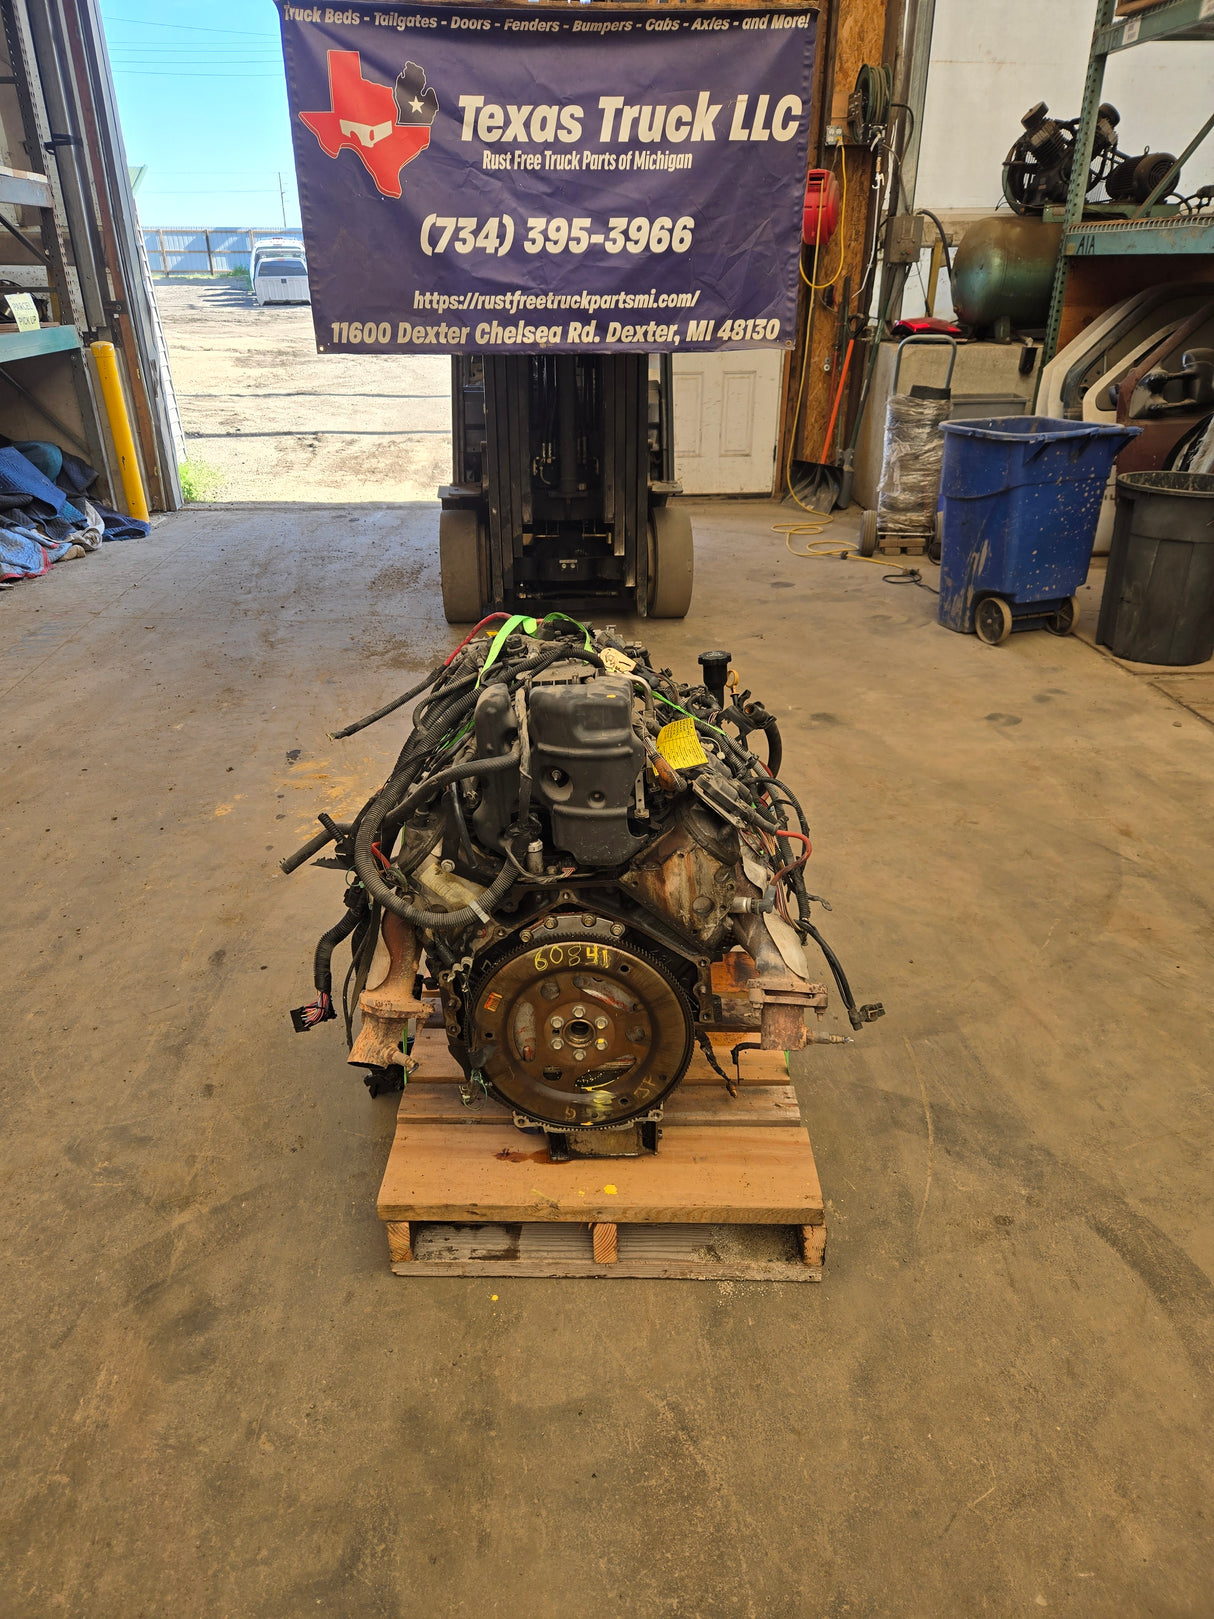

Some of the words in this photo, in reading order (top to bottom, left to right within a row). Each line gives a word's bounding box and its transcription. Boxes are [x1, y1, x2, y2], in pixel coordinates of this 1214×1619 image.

[284, 5, 321, 22] Truck
[324, 9, 360, 24] Beds
[375, 13, 437, 30] Tailgates
[451, 16, 491, 29] Doors
[504, 19, 560, 32] Fenders
[573, 20, 632, 34] Bumpers
[646, 18, 680, 30] Cabs
[691, 17, 730, 30] Axles
[742, 15, 768, 29] and
[771, 13, 810, 29] More!
[459, 95, 584, 143] Texas
[599, 91, 722, 142] Truck
[729, 94, 802, 141] LLC
[483, 150, 511, 169] Rust
[514, 150, 541, 169] Free
[545, 151, 580, 170] Truck
[582, 151, 616, 169] Parts
[619, 151, 632, 170] of
[634, 151, 692, 172] Michigan
[421, 213, 514, 256] (734)
[524, 216, 694, 253] 395-3966
[414, 289, 700, 314] https://rustfreetruckpartsmi.com/
[332, 322, 391, 344] 11600
[397, 322, 470, 344] Dexter
[475, 320, 562, 344] Chelsea
[567, 320, 600, 343] Rd.
[606, 322, 680, 345] Dexter,
[686, 320, 714, 341] MI
[717, 319, 780, 341] 48130
